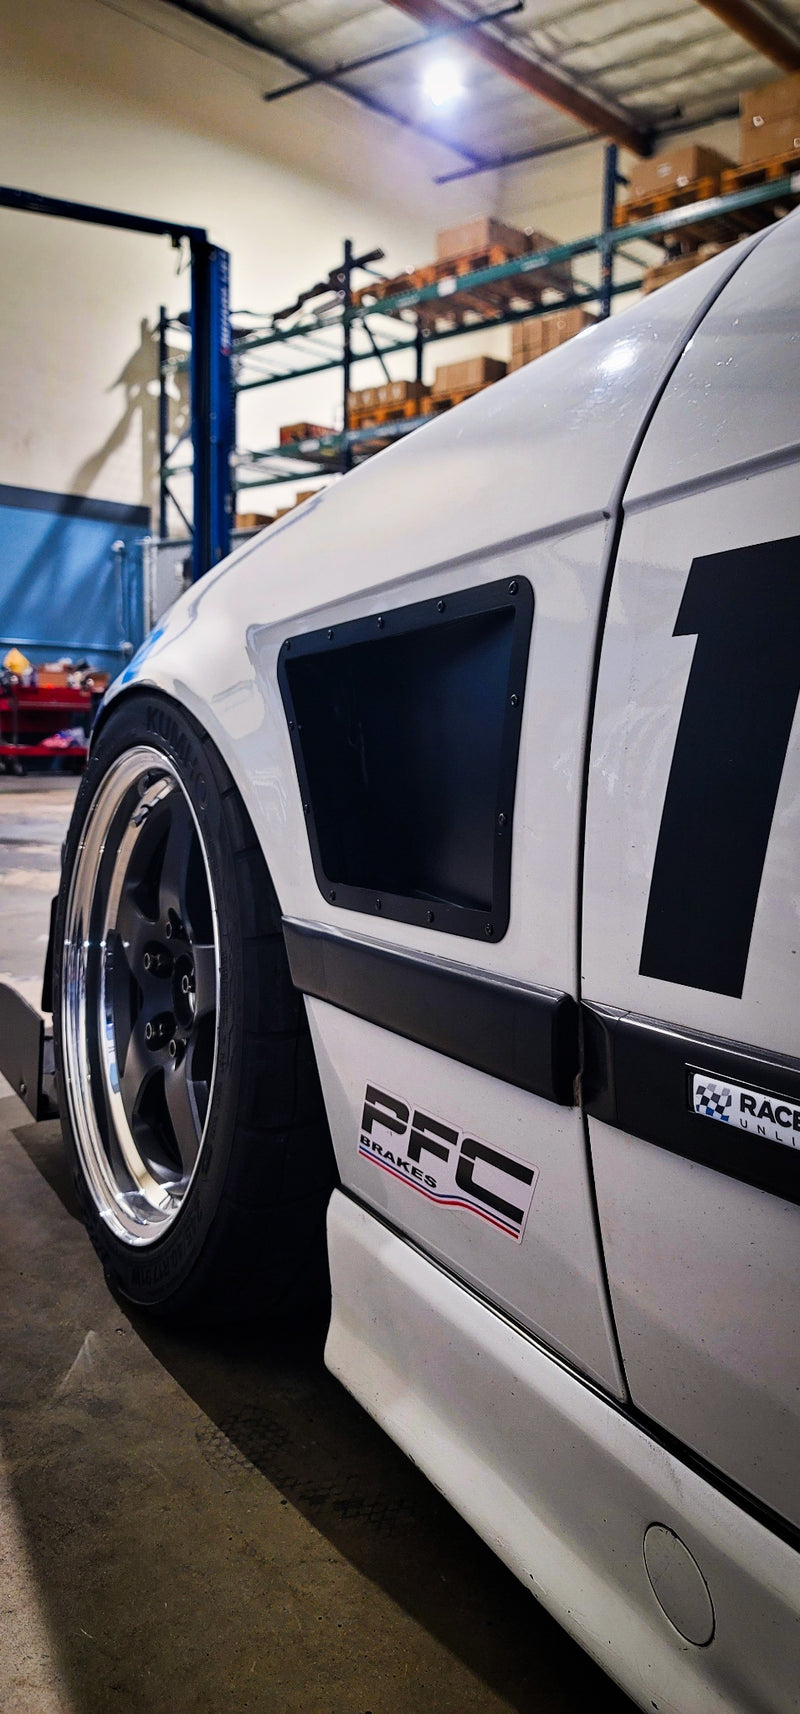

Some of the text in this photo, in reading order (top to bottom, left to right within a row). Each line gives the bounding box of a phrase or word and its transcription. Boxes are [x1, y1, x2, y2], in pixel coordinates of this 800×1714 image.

[639, 535, 800, 999] 1
[359, 1133, 437, 1189] BRAKES
[361, 1083, 535, 1225] PFC
[739, 1118, 796, 1147] UNLI
